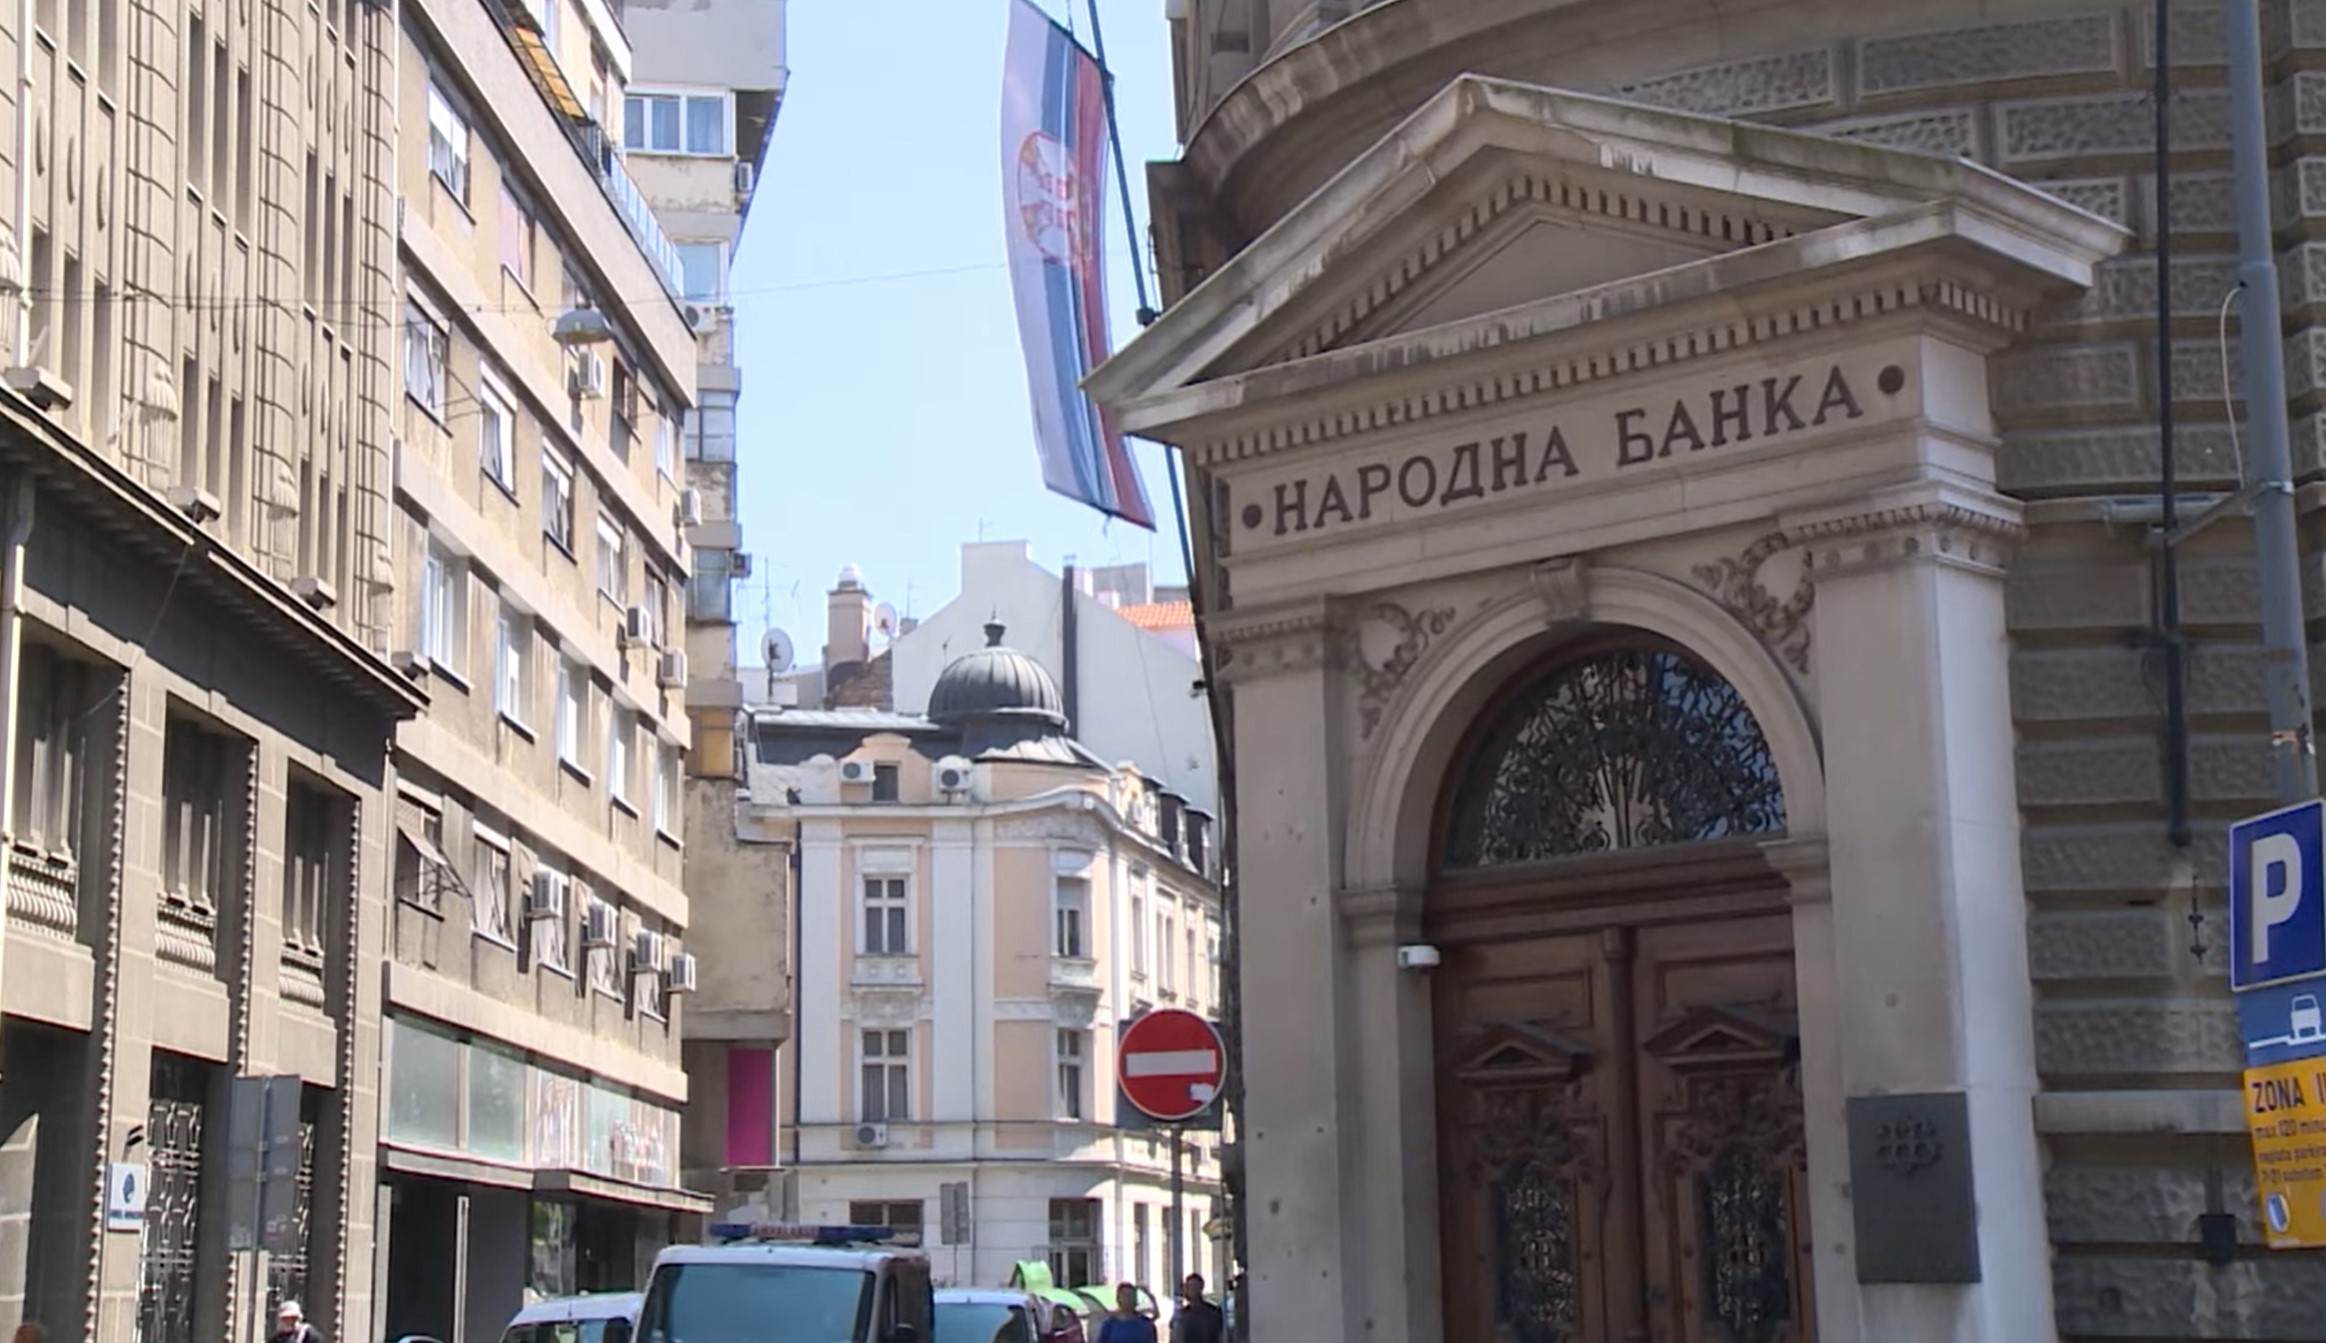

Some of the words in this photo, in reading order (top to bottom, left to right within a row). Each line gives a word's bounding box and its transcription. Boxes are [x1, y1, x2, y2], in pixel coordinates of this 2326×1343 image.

[1272, 424, 1579, 536] НАРОДНА
[1615, 365, 1863, 468] БАНКА
[2252, 833, 2303, 964] P
[2252, 1077, 2307, 1113] ZONA
